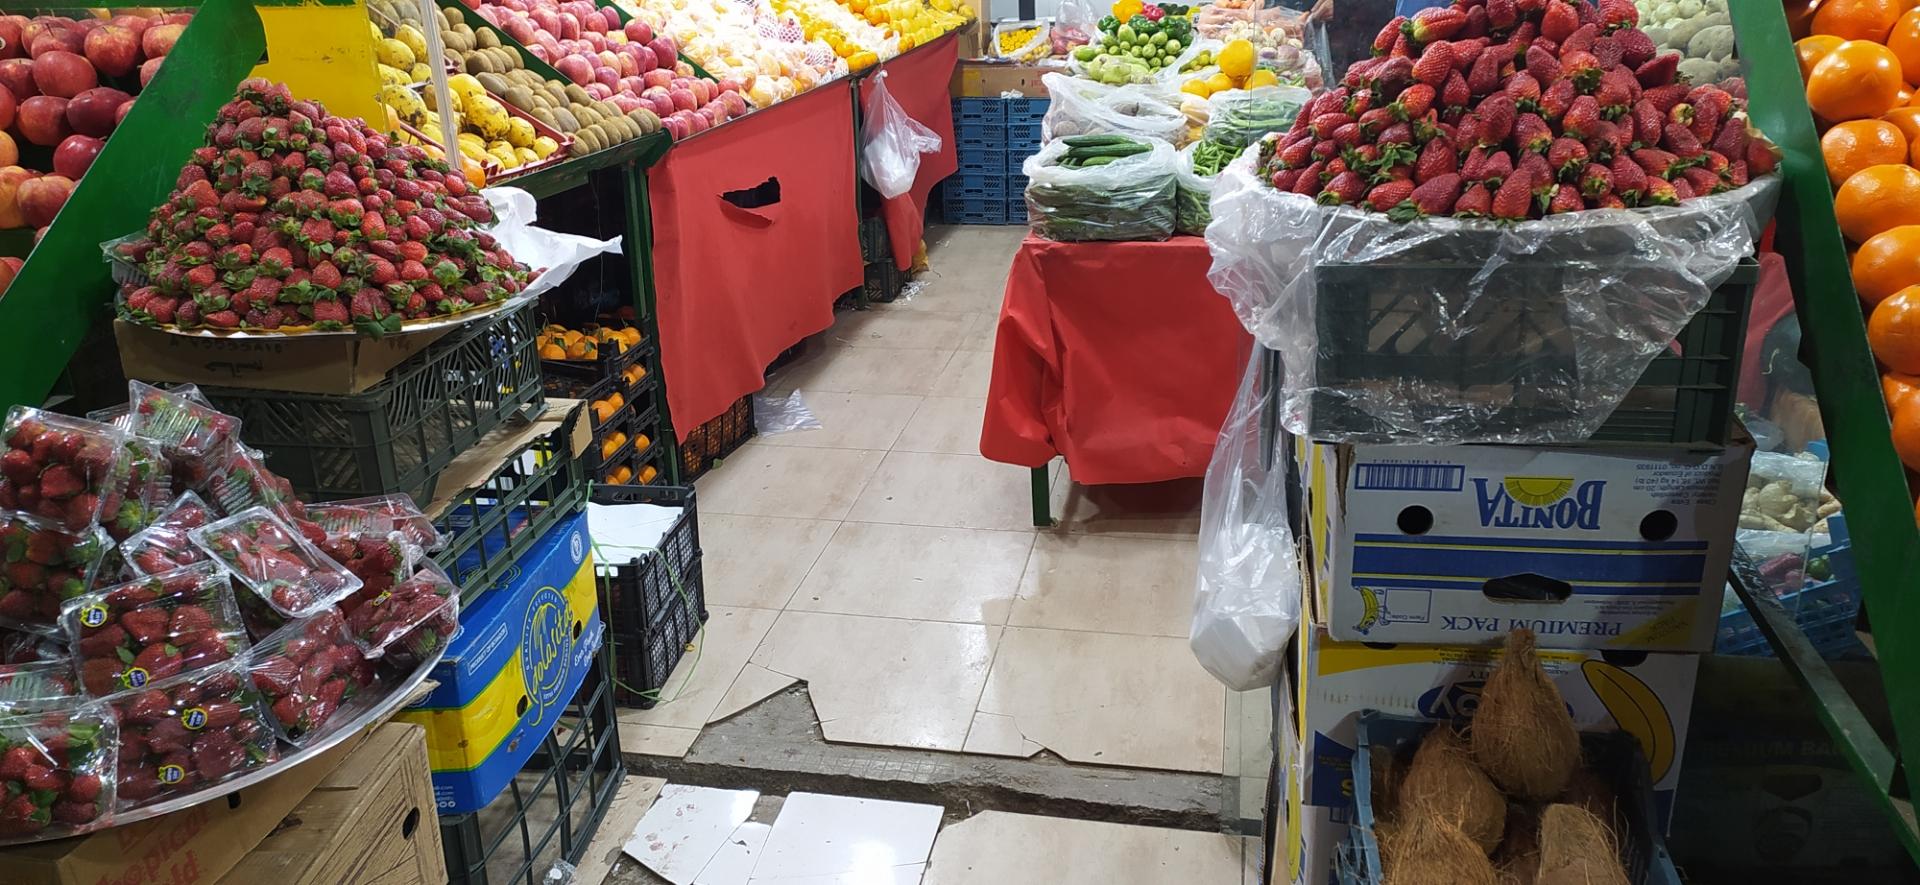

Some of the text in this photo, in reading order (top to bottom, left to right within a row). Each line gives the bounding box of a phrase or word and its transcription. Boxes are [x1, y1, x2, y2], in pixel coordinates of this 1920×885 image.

[1473, 477, 1607, 531] BONITA
[1440, 615, 1500, 632] PACK
[1508, 618, 1623, 637] PREMIUM
